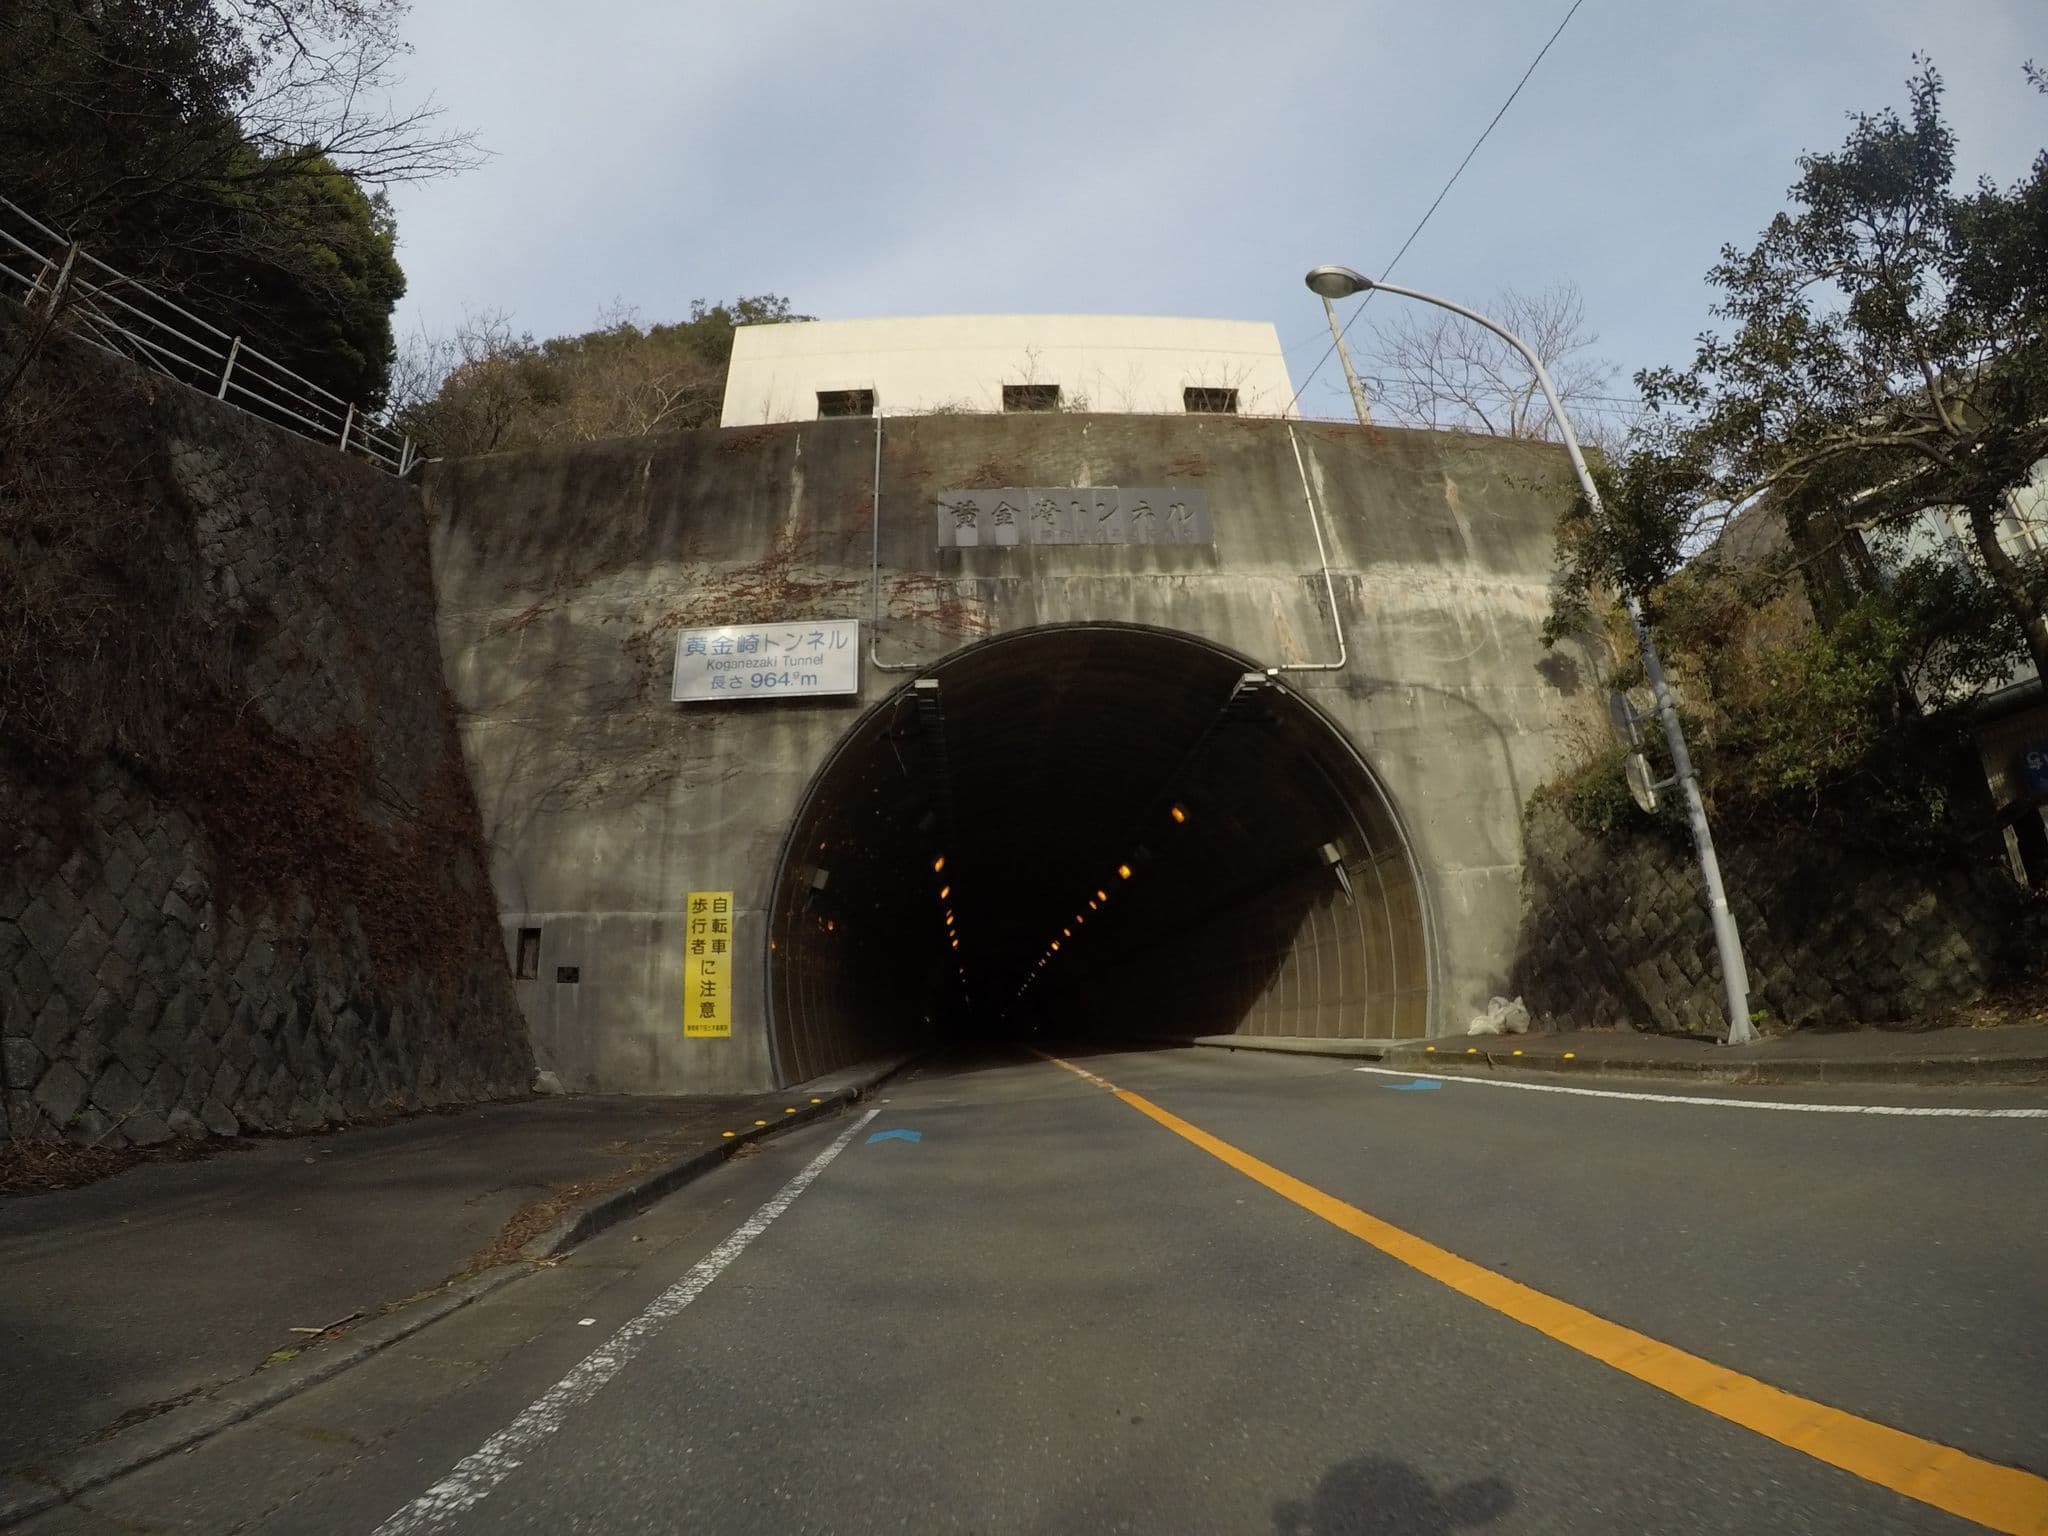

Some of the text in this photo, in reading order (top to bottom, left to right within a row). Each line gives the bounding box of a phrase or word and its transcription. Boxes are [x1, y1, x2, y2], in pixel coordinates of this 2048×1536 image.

[685, 630, 848, 657] 黄金崎トンネル
[707, 653, 824, 671] Koganezaki Tunnel
[711, 674, 743, 690] 長さ
[691, 899, 707, 955] 歩行者
[711, 897, 727, 954] 自転車
[699, 960, 716, 1018] に注意
